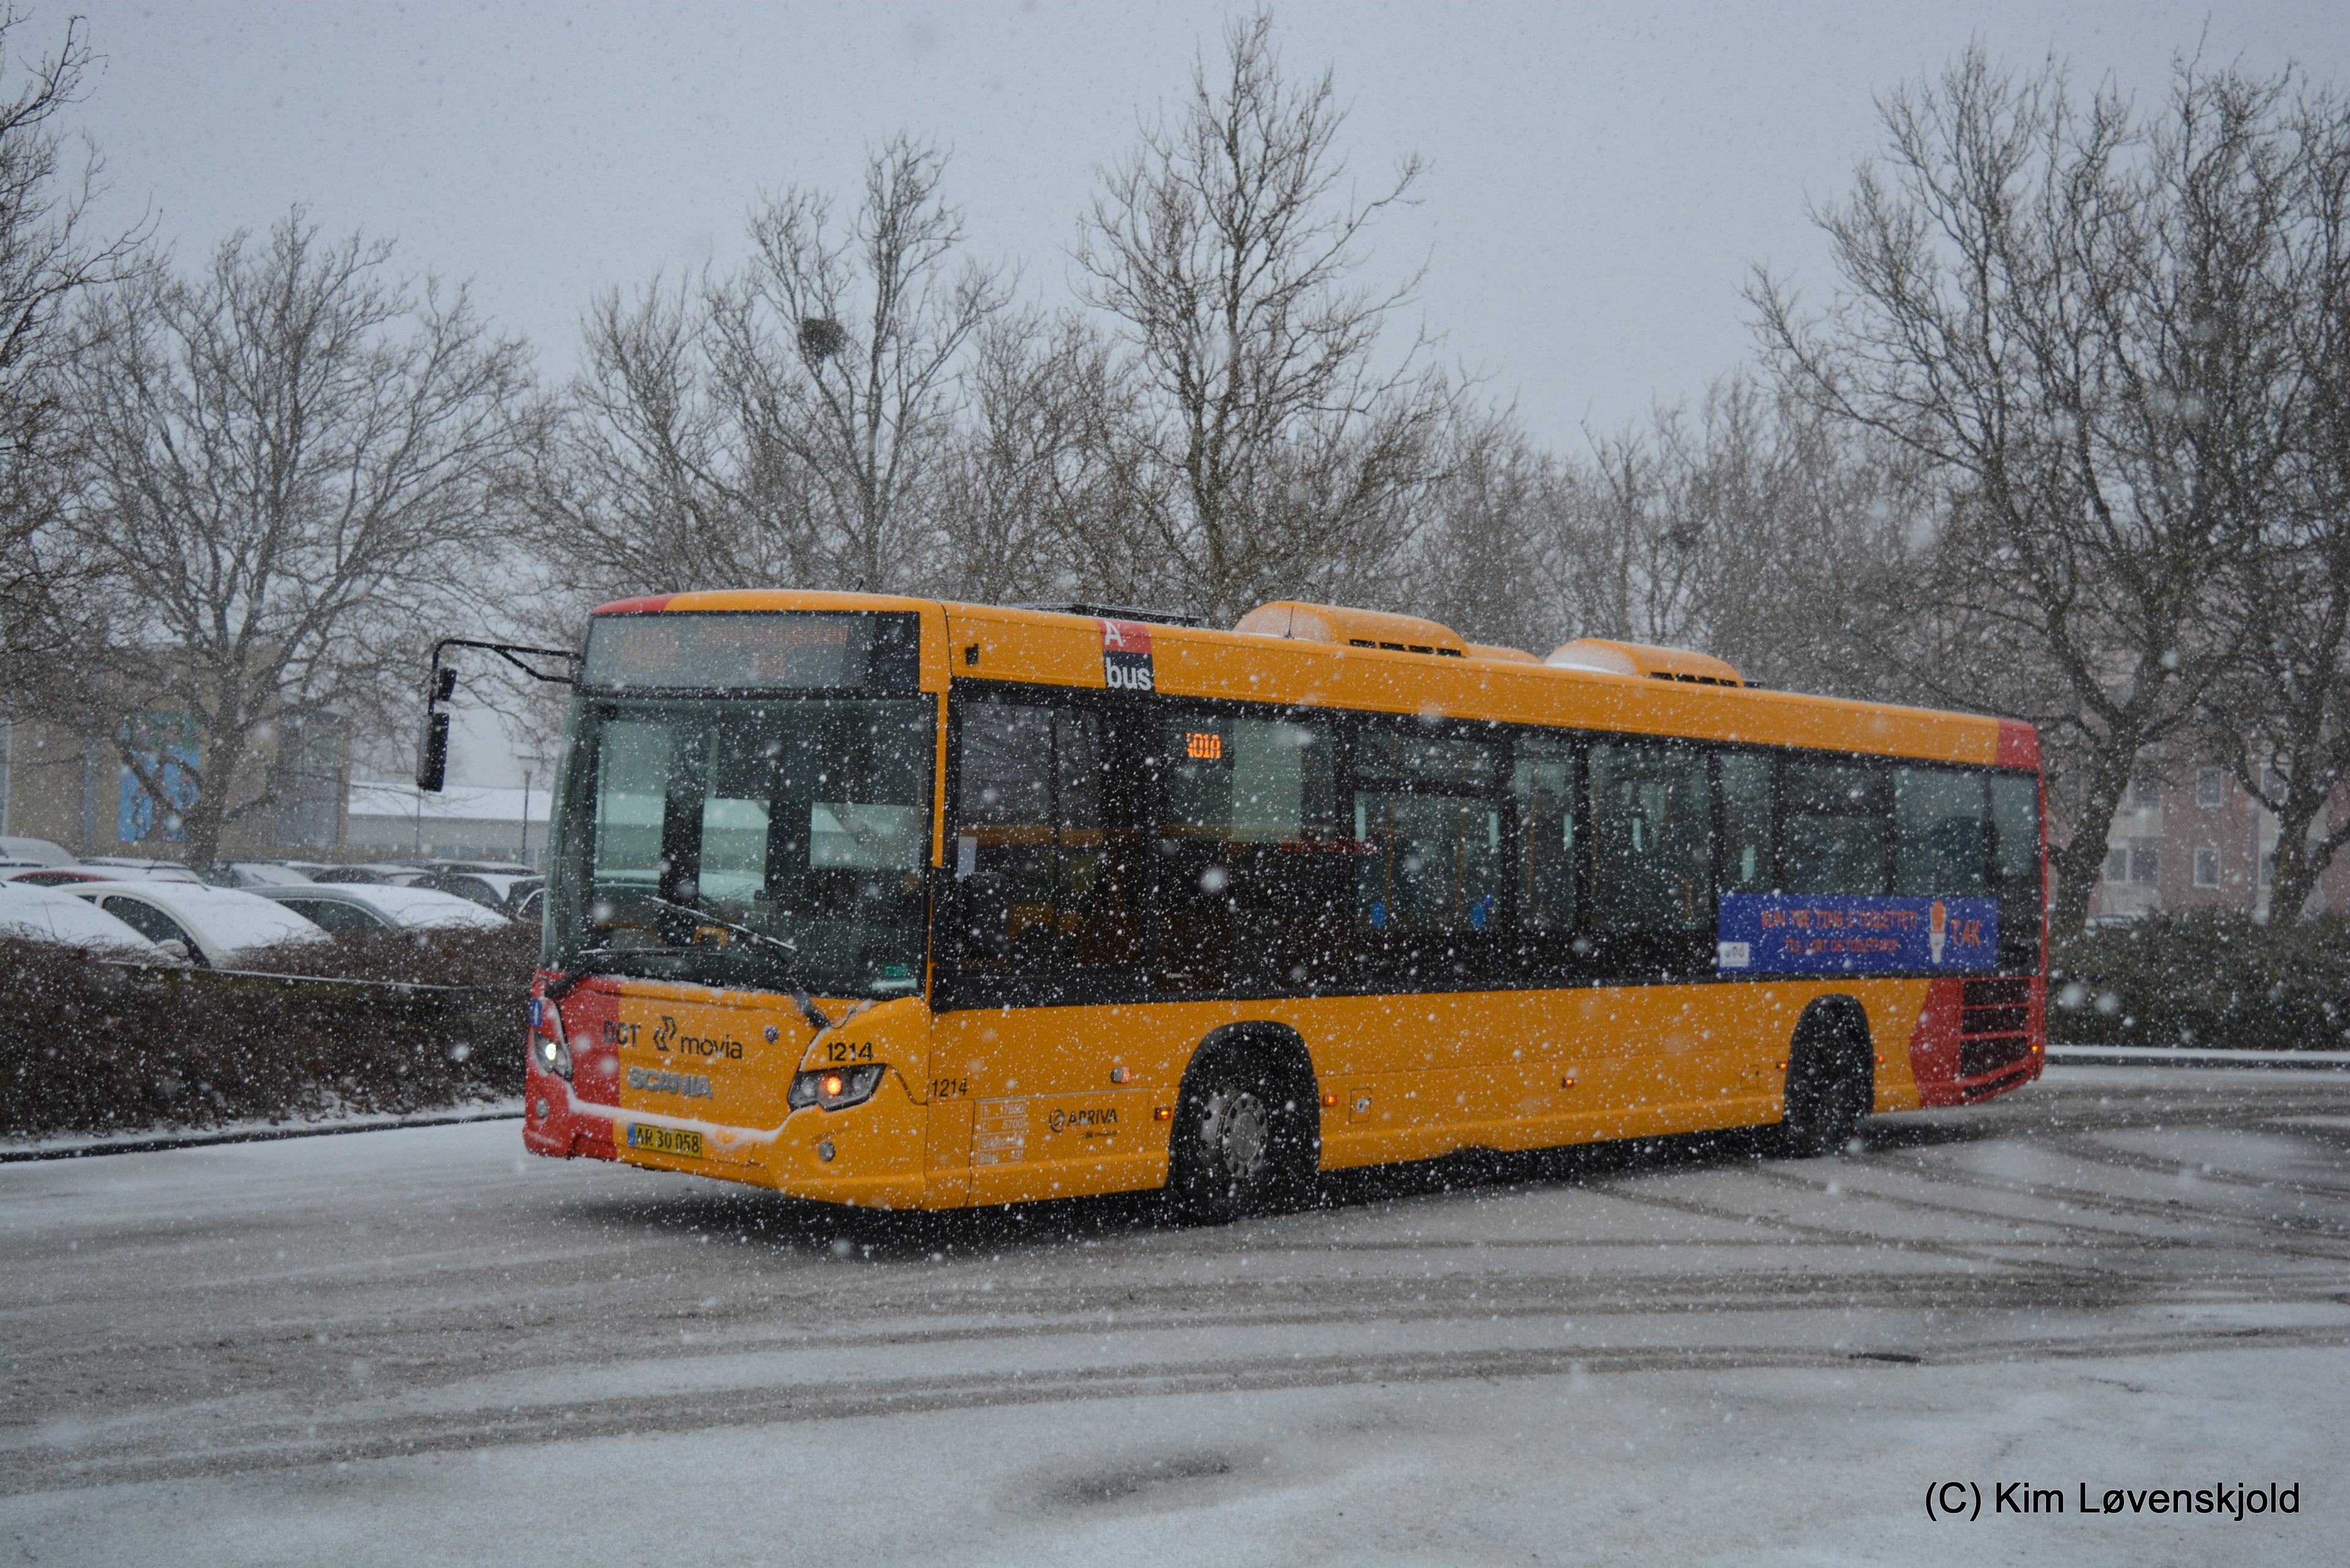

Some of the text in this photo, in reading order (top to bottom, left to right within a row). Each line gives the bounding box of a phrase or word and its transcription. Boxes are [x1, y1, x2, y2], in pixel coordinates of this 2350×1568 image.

[1104, 621, 1124, 647] A
[1105, 657, 1152, 690] bus
[1815, 910, 1844, 928] TING
[1950, 919, 1982, 946] TAK
[603, 1021, 641, 1047] DOT
[681, 1034, 742, 1059] movia
[826, 1042, 874, 1062] 1214
[628, 1066, 714, 1099] SCANIA
[932, 1078, 968, 1097] 1214
[1002, 1119, 1023, 1129] 5700
[1067, 1108, 1117, 1126] ARRIVA
[636, 1128, 699, 1153] AR 30 058
